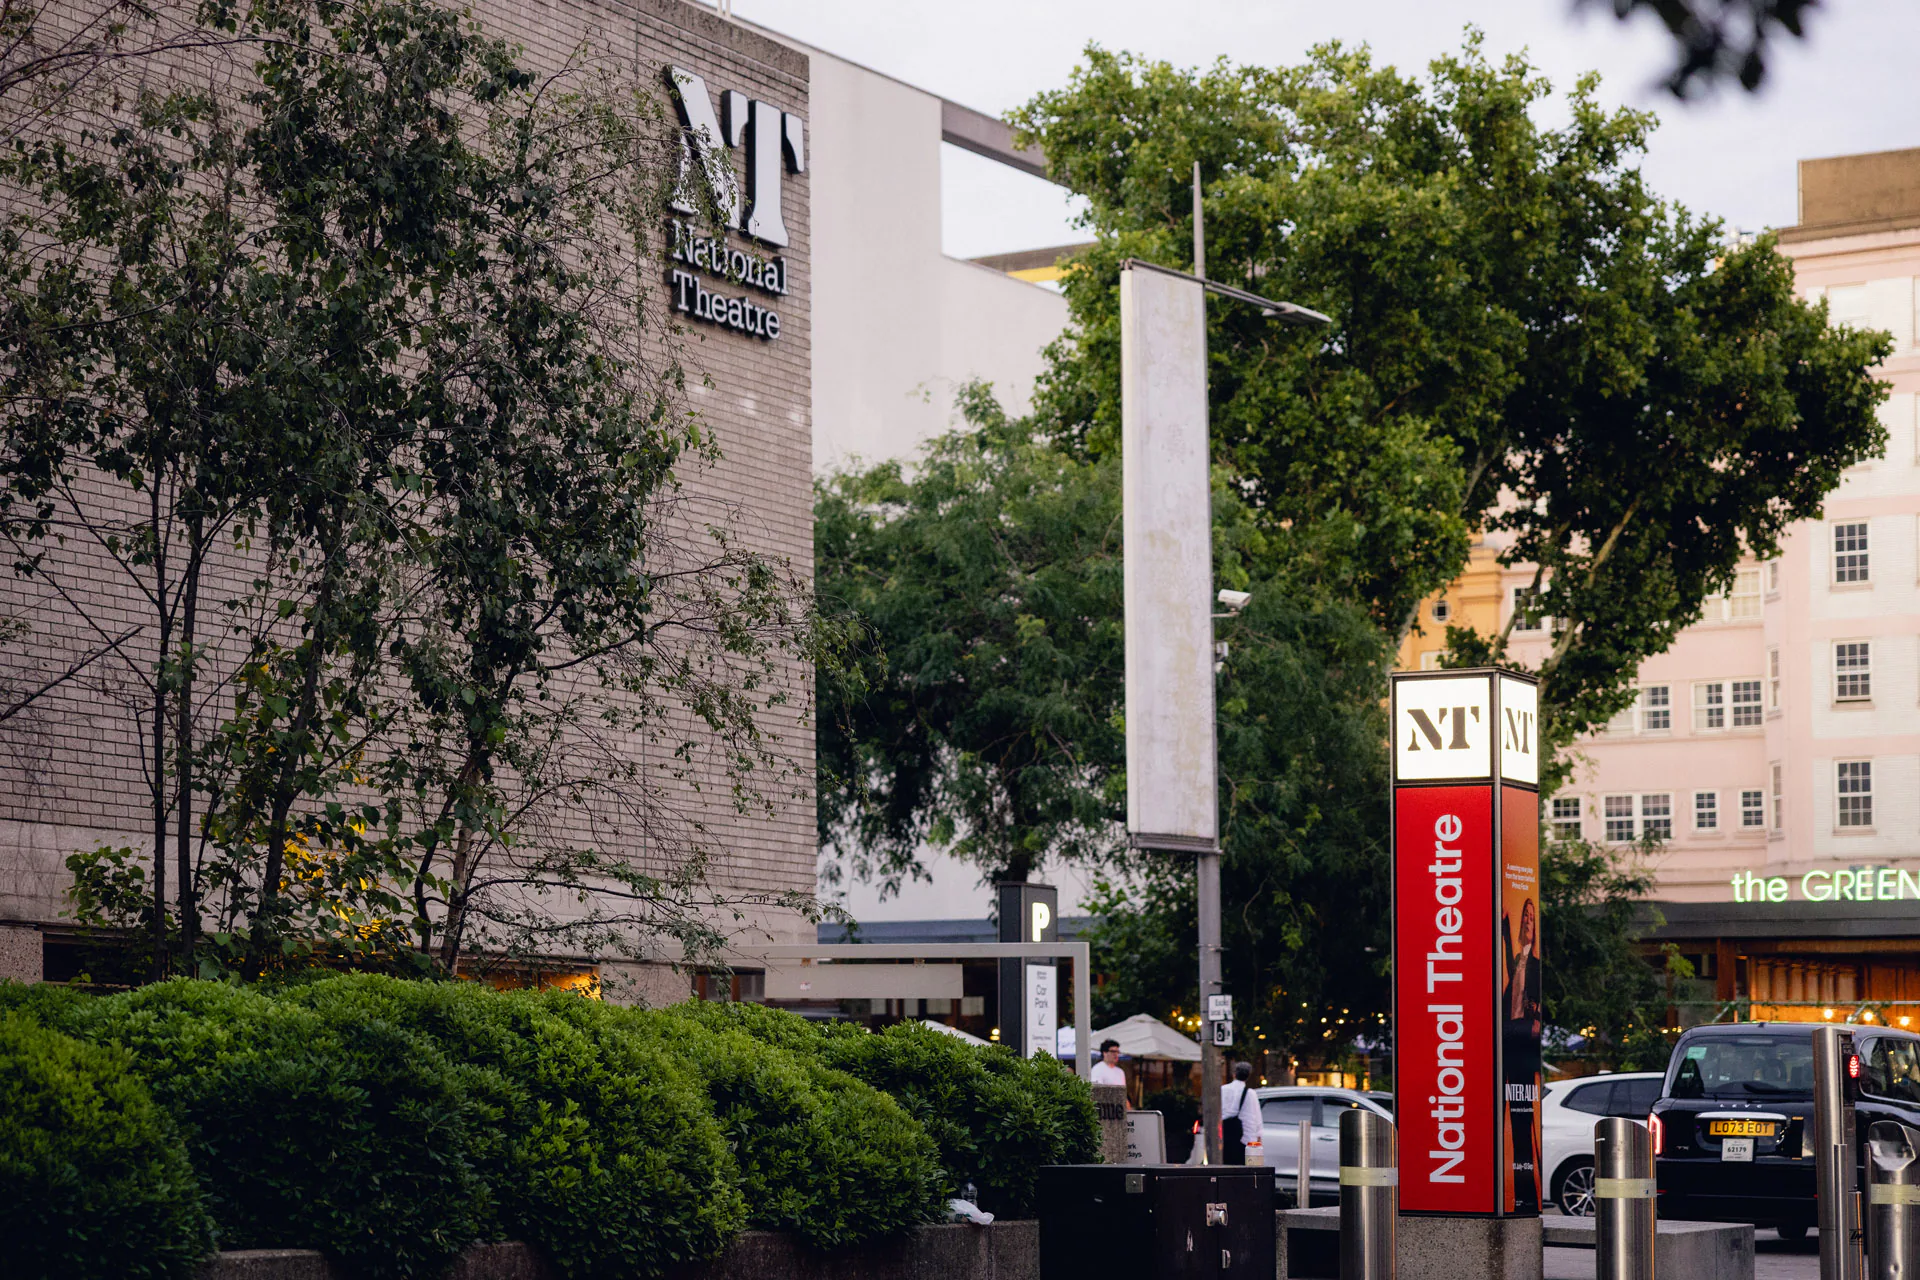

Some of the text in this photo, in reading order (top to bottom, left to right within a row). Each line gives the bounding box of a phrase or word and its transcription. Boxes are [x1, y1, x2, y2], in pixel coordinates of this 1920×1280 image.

[668, 64, 804, 248] NT
[672, 219, 789, 295] National
[673, 269, 780, 339] Theatre
[1407, 706, 1479, 751] NT
[1505, 707, 1533, 754] NT
[1730, 869, 1920, 902] the GREEN
[1031, 902, 1050, 942] P
[1427, 814, 1465, 1184] National Theatre
[1505, 1083, 1524, 1101] INTER
[1714, 1122, 1770, 1133] LO73 EOT
